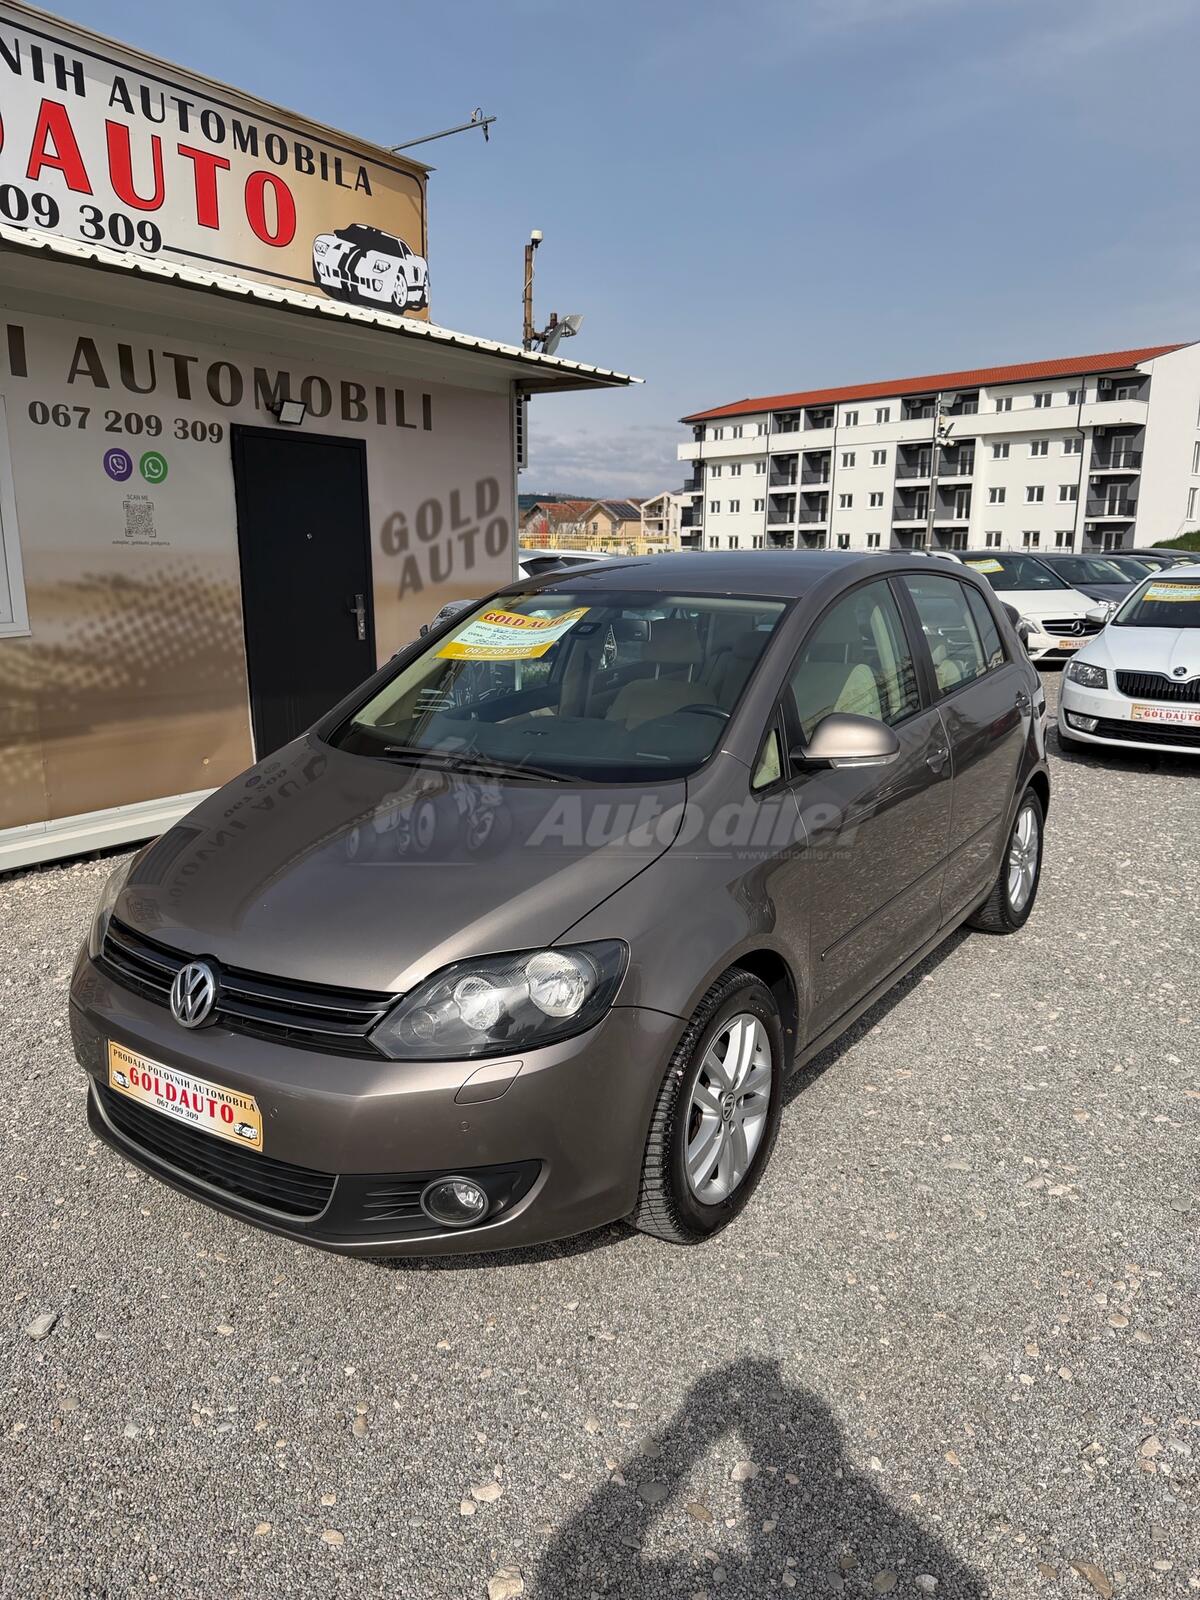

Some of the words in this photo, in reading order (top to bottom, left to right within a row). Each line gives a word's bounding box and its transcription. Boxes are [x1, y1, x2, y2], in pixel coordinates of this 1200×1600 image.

[108, 75, 373, 197] AUTOMOBILA
[0, 98, 297, 248] AUTO
[79, 205, 162, 253] 309
[67, 336, 433, 431] AUTOMOBILI
[28, 401, 91, 429] 067
[104, 409, 163, 438] 209
[174, 418, 224, 444] 309
[380, 476, 501, 557] GOLD
[399, 516, 510, 602] AUTO
[483, 612, 525, 627] GOLD
[1144, 710, 1200, 722] GOLDAUTO
[113, 1048, 146, 1071] PRODAJA
[148, 1065, 191, 1089] POLOVNIH
[193, 1083, 256, 1112] AUTOMOBILA
[129, 1066, 234, 1124] GOLDAUTO
[156, 1098, 169, 1109] 067
[170, 1103, 184, 1115] 209
[184, 1109, 199, 1121] 309
